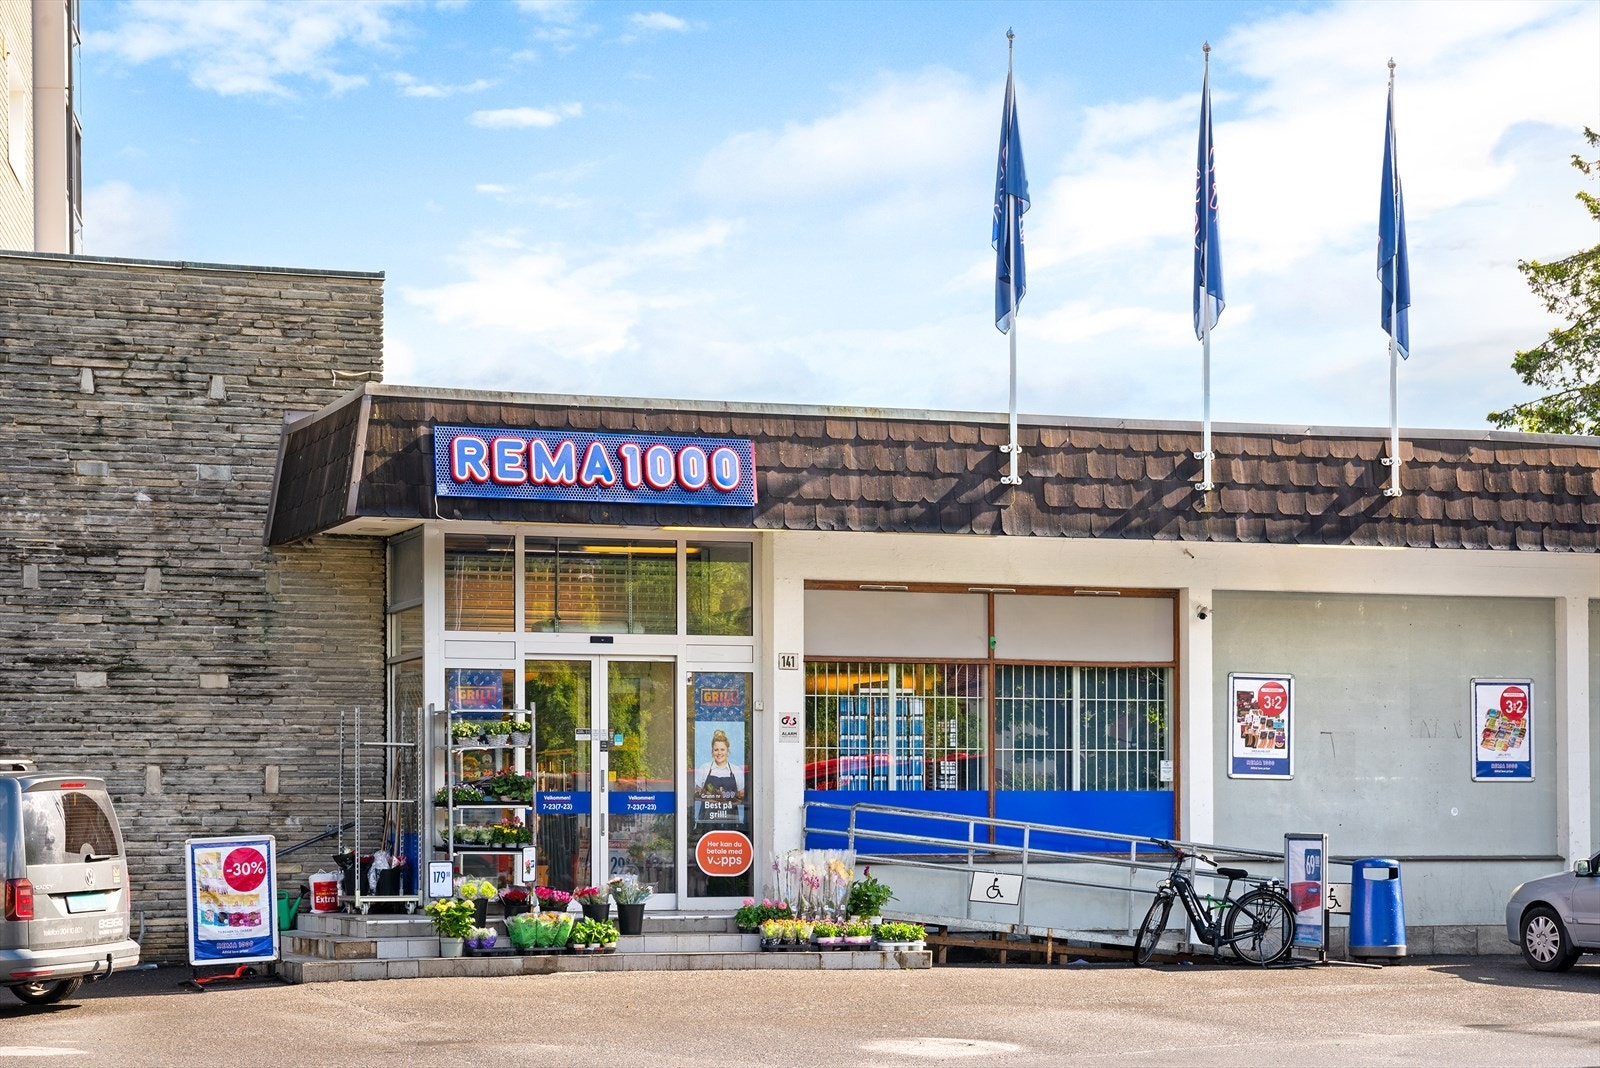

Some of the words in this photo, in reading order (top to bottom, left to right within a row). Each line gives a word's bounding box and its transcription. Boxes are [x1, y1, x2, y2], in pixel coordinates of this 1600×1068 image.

[450, 436, 616, 487] REMA
[618, 442, 741, 493] 1000
[781, 655, 795, 668] 141
[459, 689, 493, 700] GRILL
[703, 691, 738, 702] GRILL
[1263, 695, 1272, 709] 3
[1274, 695, 1282, 709] 2
[1505, 700, 1513, 714] 3
[1516, 700, 1524, 714] 2
[542, 803, 573, 811] 7-23(7-23)
[627, 803, 657, 811] 7-23(7-23)
[704, 801, 721, 809] Best
[723, 800, 733, 811] på
[709, 810, 727, 820] grill!
[226, 860, 264, 876] -30%
[1305, 855, 1315, 875] 69
[433, 871, 446, 884] 179
[315, 895, 336, 904] Extra
